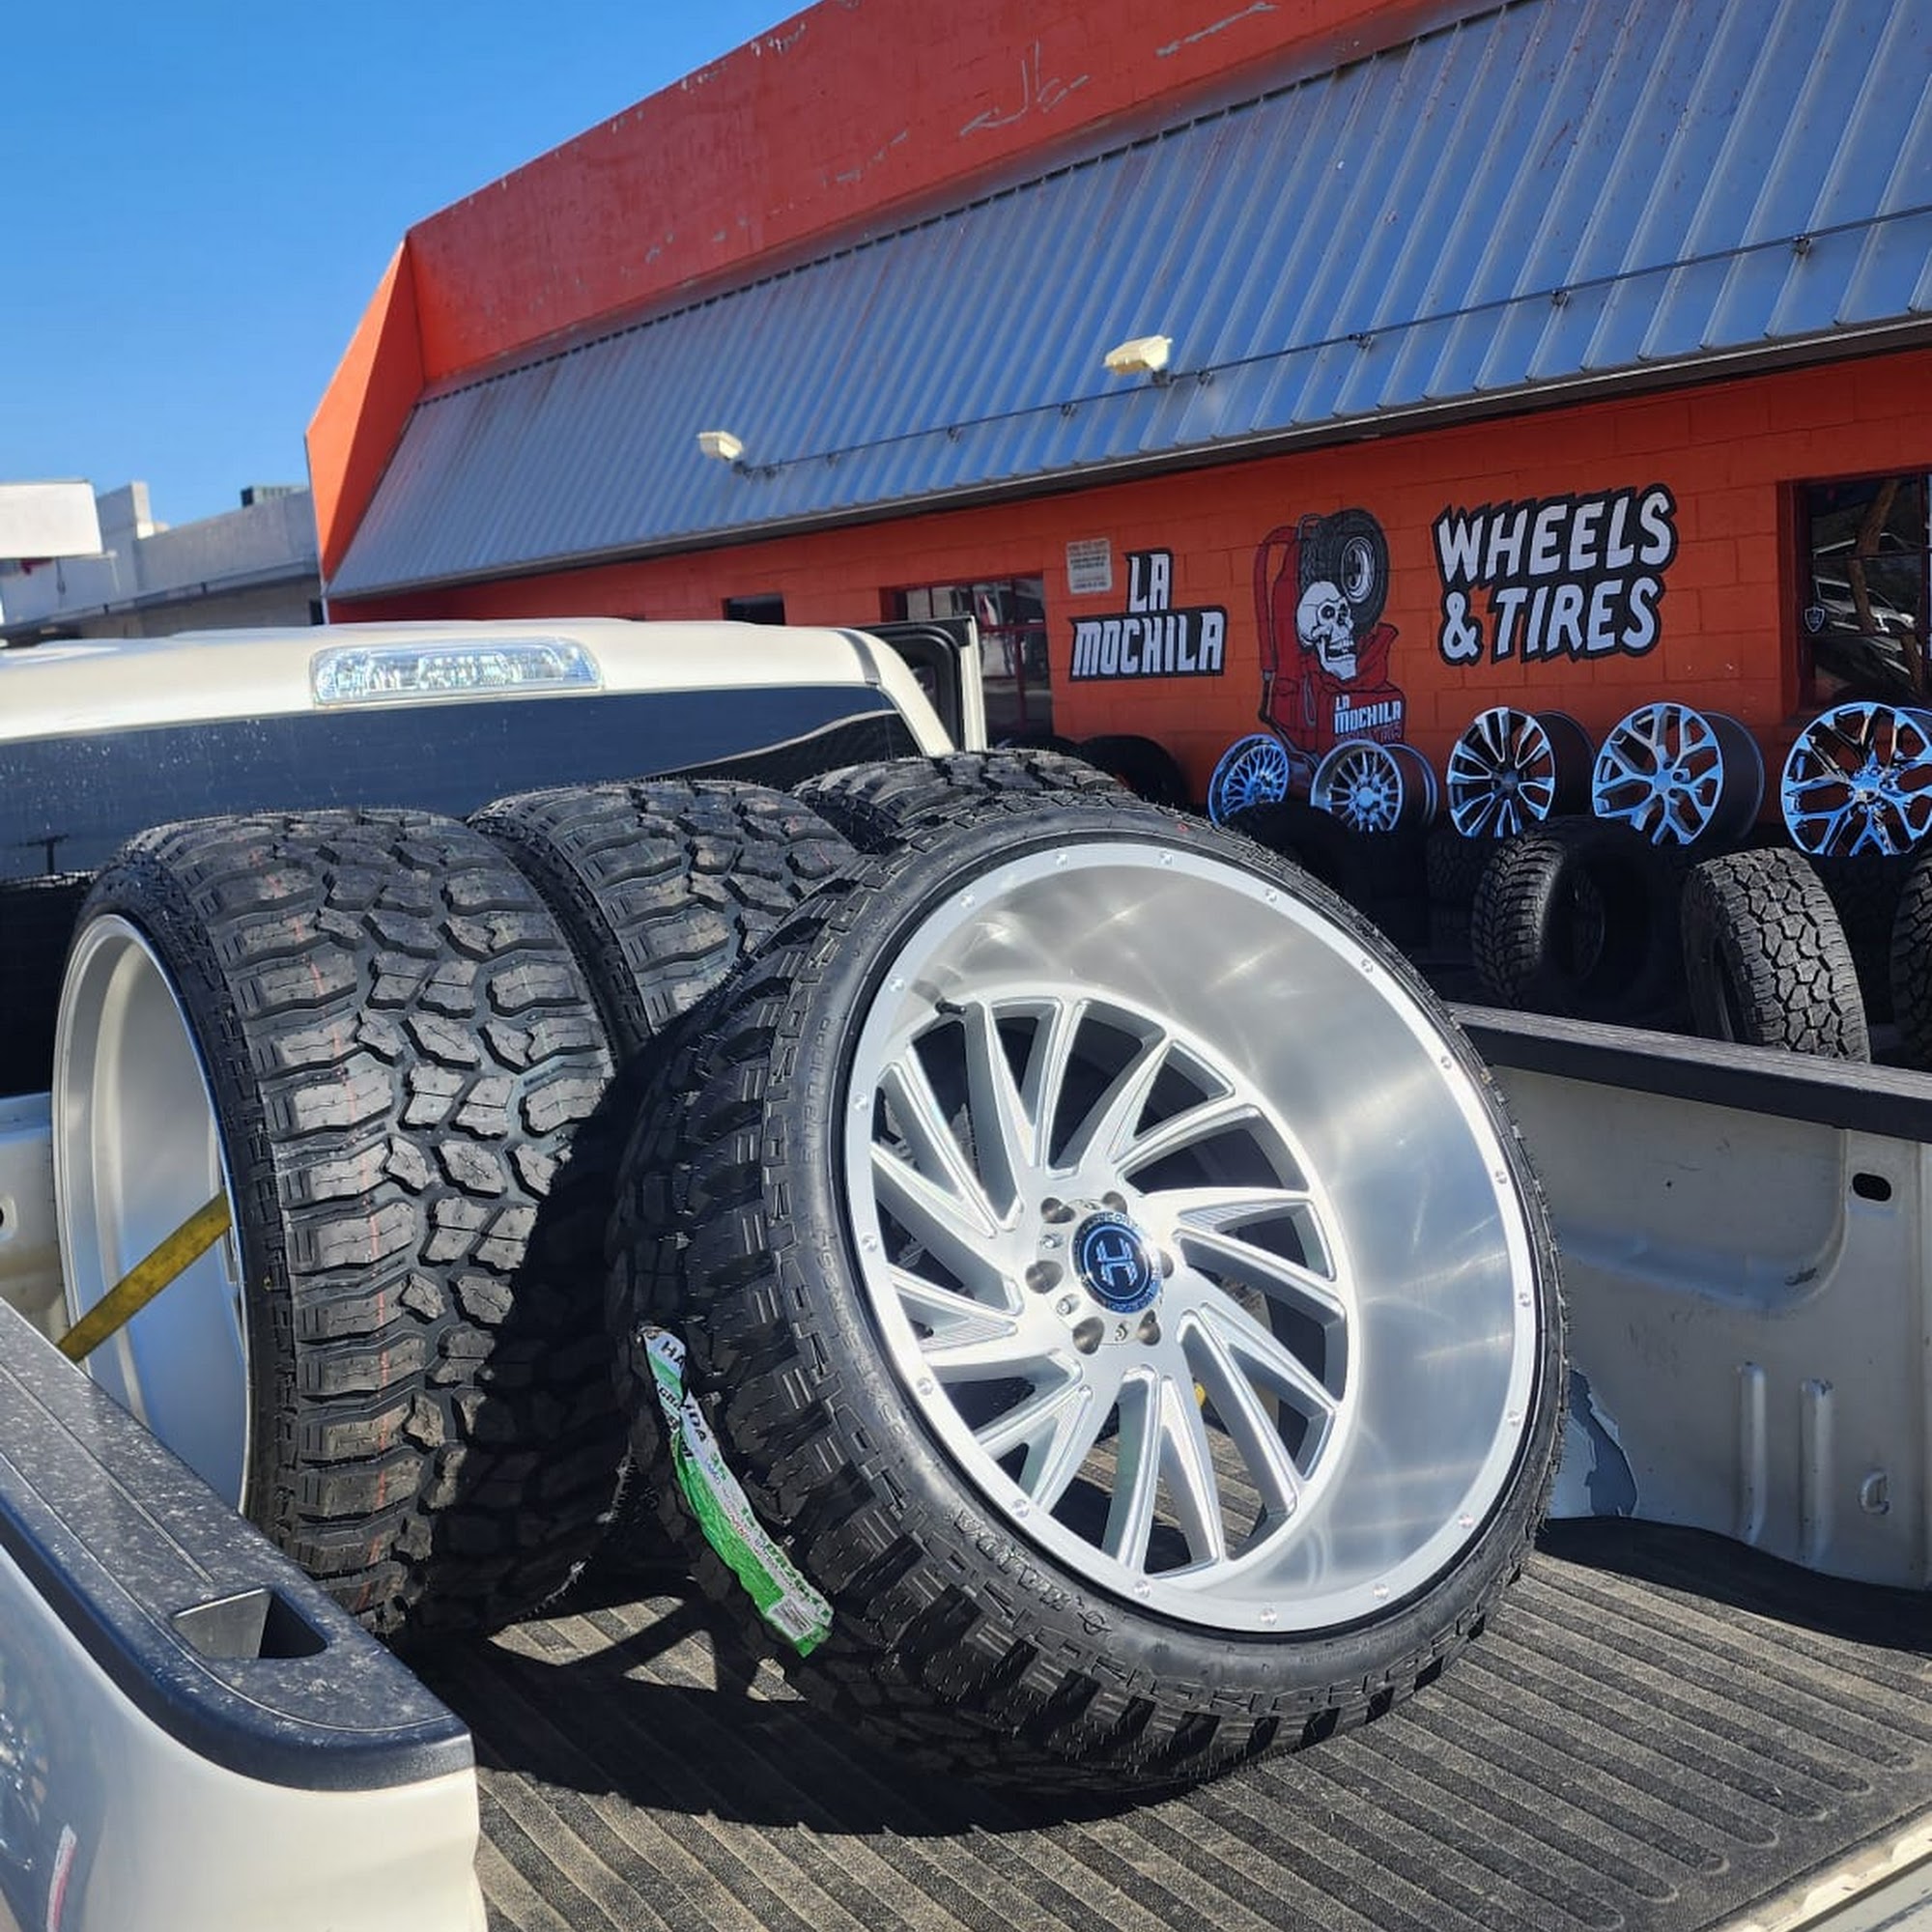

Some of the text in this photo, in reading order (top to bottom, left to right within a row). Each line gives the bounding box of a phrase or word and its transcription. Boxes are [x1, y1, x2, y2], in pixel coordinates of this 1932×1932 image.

[1437, 491, 1672, 582] WHEELS
[1128, 553, 1170, 613] LA
[1071, 611, 1225, 677] MOCHILA
[1441, 577, 1660, 660] & TIRES
[1334, 699, 1402, 735] MOCHILA
[1335, 694, 1350, 712] LA
